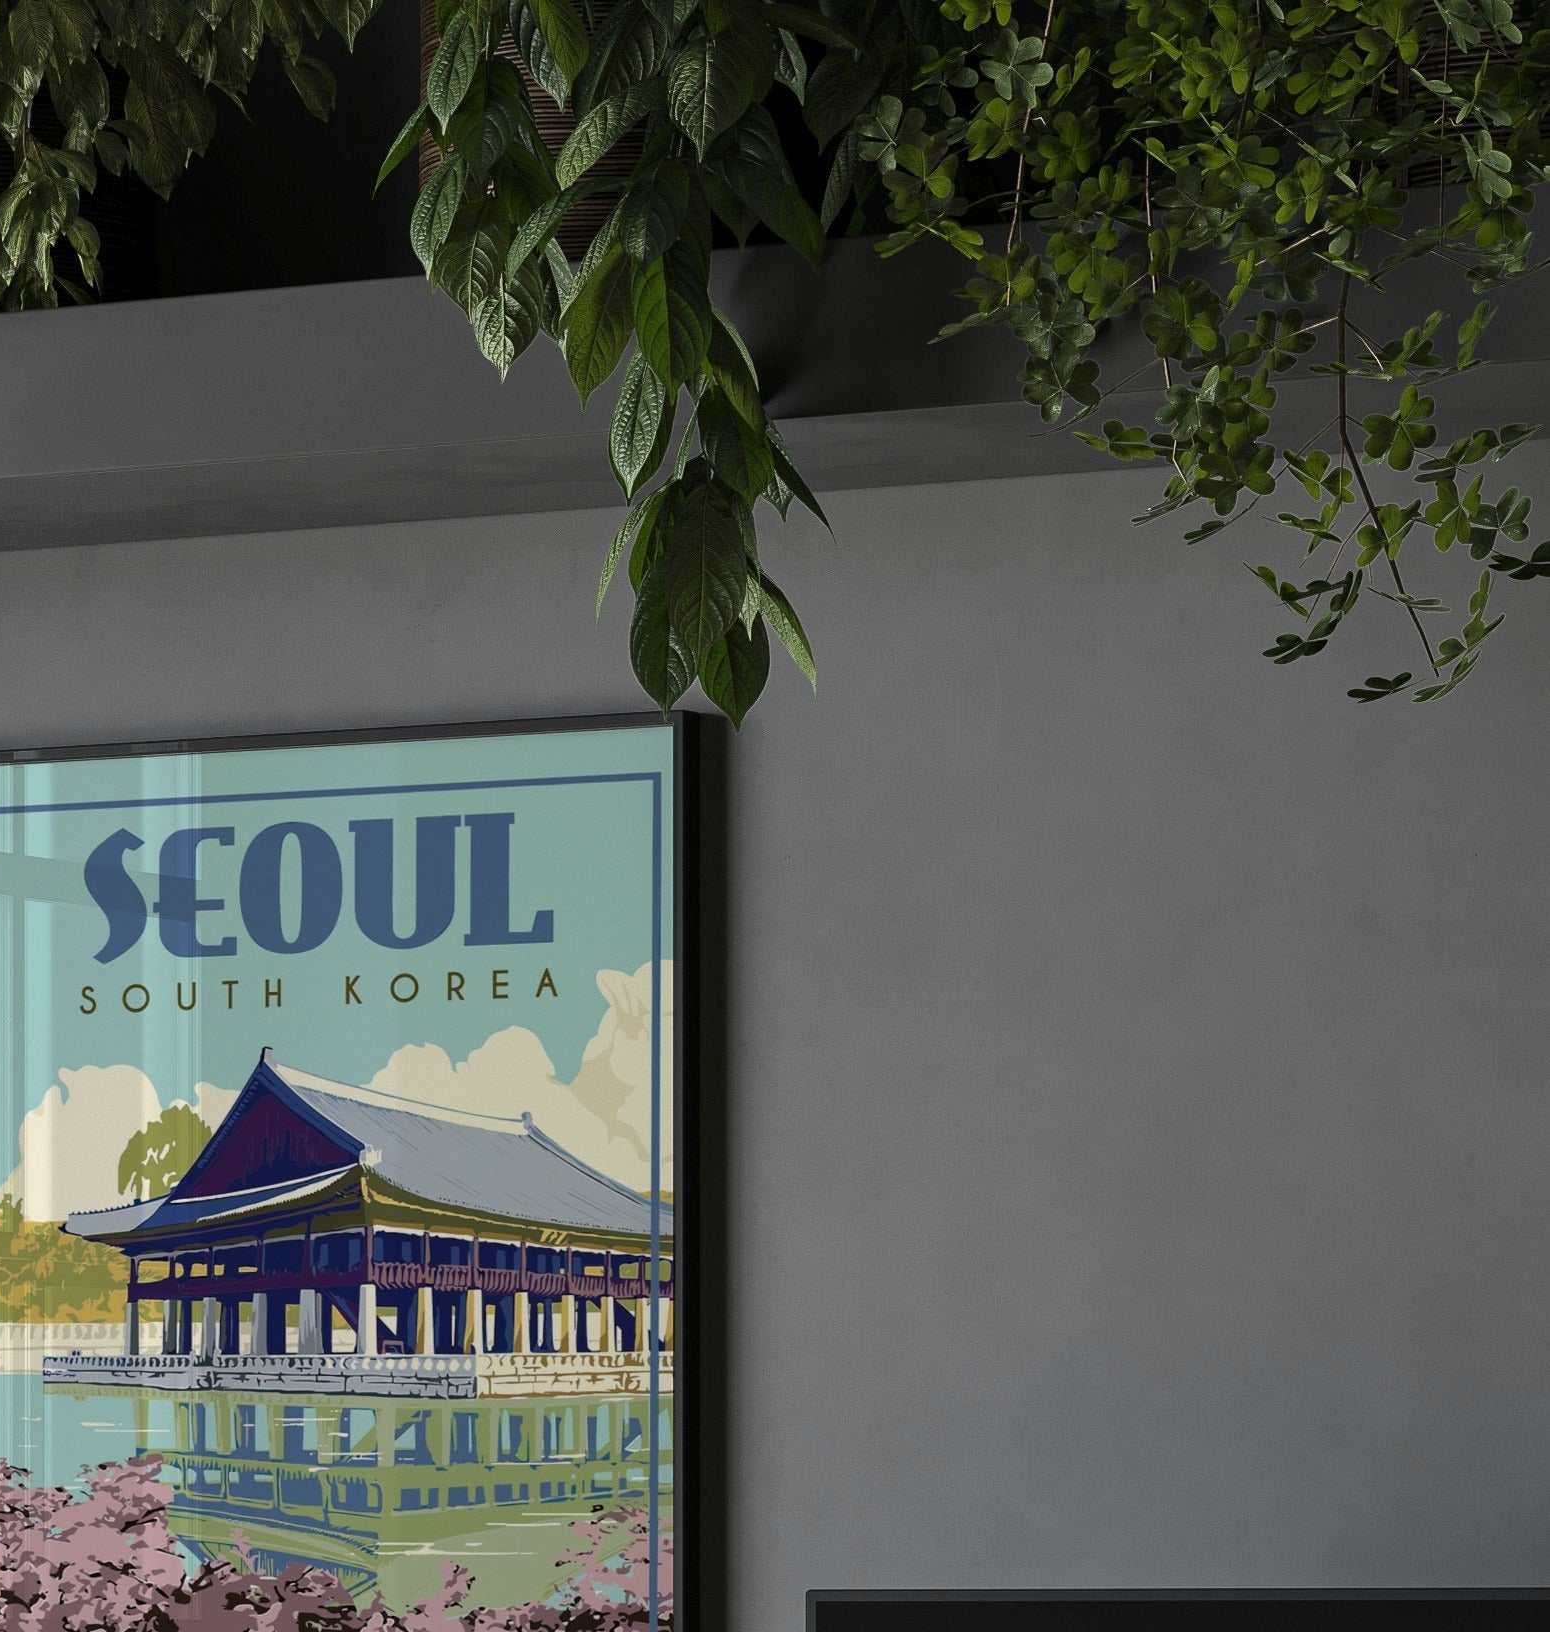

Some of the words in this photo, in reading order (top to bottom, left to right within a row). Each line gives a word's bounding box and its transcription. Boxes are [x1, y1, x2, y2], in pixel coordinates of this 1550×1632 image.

[83, 812, 554, 965] SEOUL
[79, 978, 282, 1014] SOUTH
[345, 968, 558, 1005] KOREA
